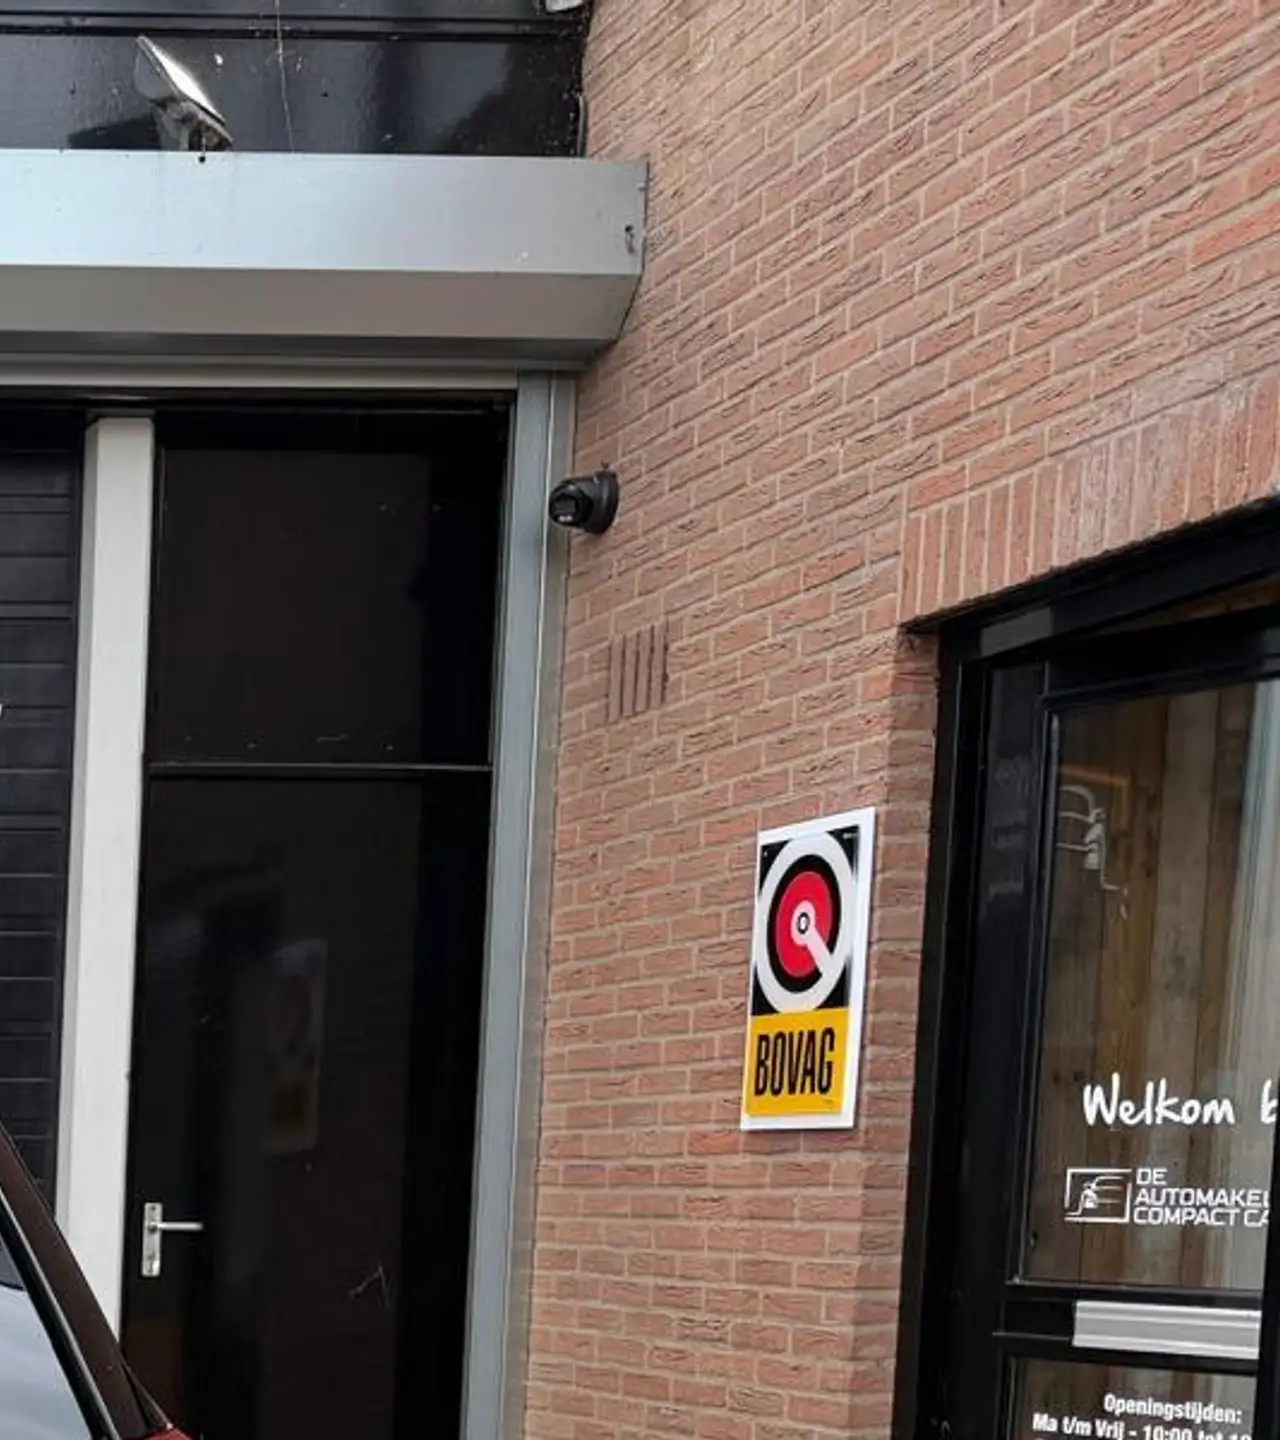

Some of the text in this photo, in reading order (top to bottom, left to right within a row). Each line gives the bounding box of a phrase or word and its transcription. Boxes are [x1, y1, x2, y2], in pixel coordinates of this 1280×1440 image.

[753, 1026, 836, 1098] BOVAG
[1082, 1072, 1236, 1127] Welkom
[1135, 1168, 1169, 1186] DE
[1132, 1207, 1241, 1227] COMPACT
[1104, 1393, 1242, 1424] Openingstijden:
[1032, 1413, 1058, 1433] Ma
[1063, 1415, 1092, 1437] t/m
